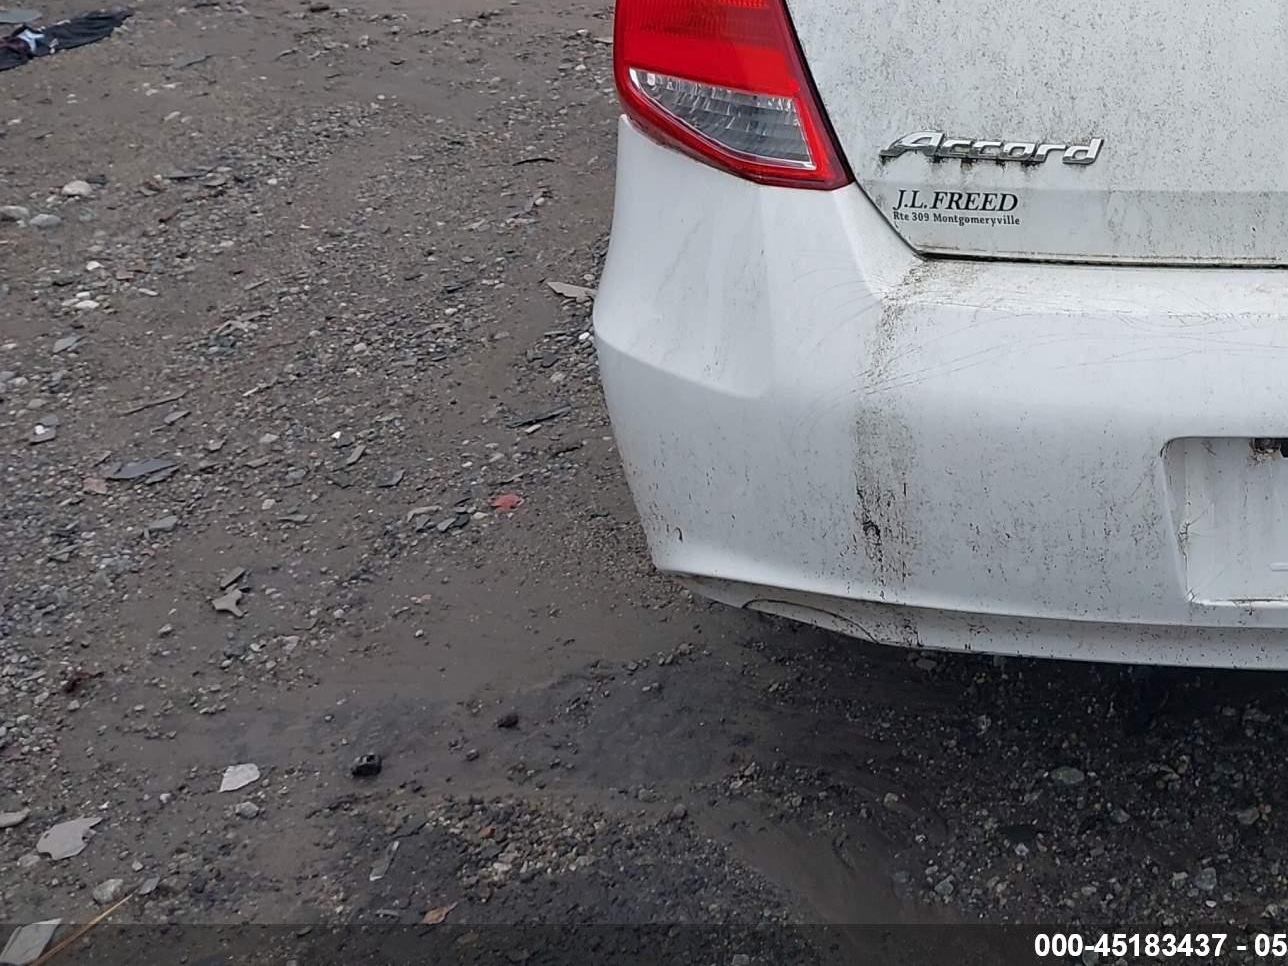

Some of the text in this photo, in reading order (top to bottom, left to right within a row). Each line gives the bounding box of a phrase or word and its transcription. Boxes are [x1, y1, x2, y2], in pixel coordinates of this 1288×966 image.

[879, 130, 1104, 164] Accord
[929, 191, 1019, 212] FREED
[892, 210, 1020, 227] Rte 309 Montgomeryville
